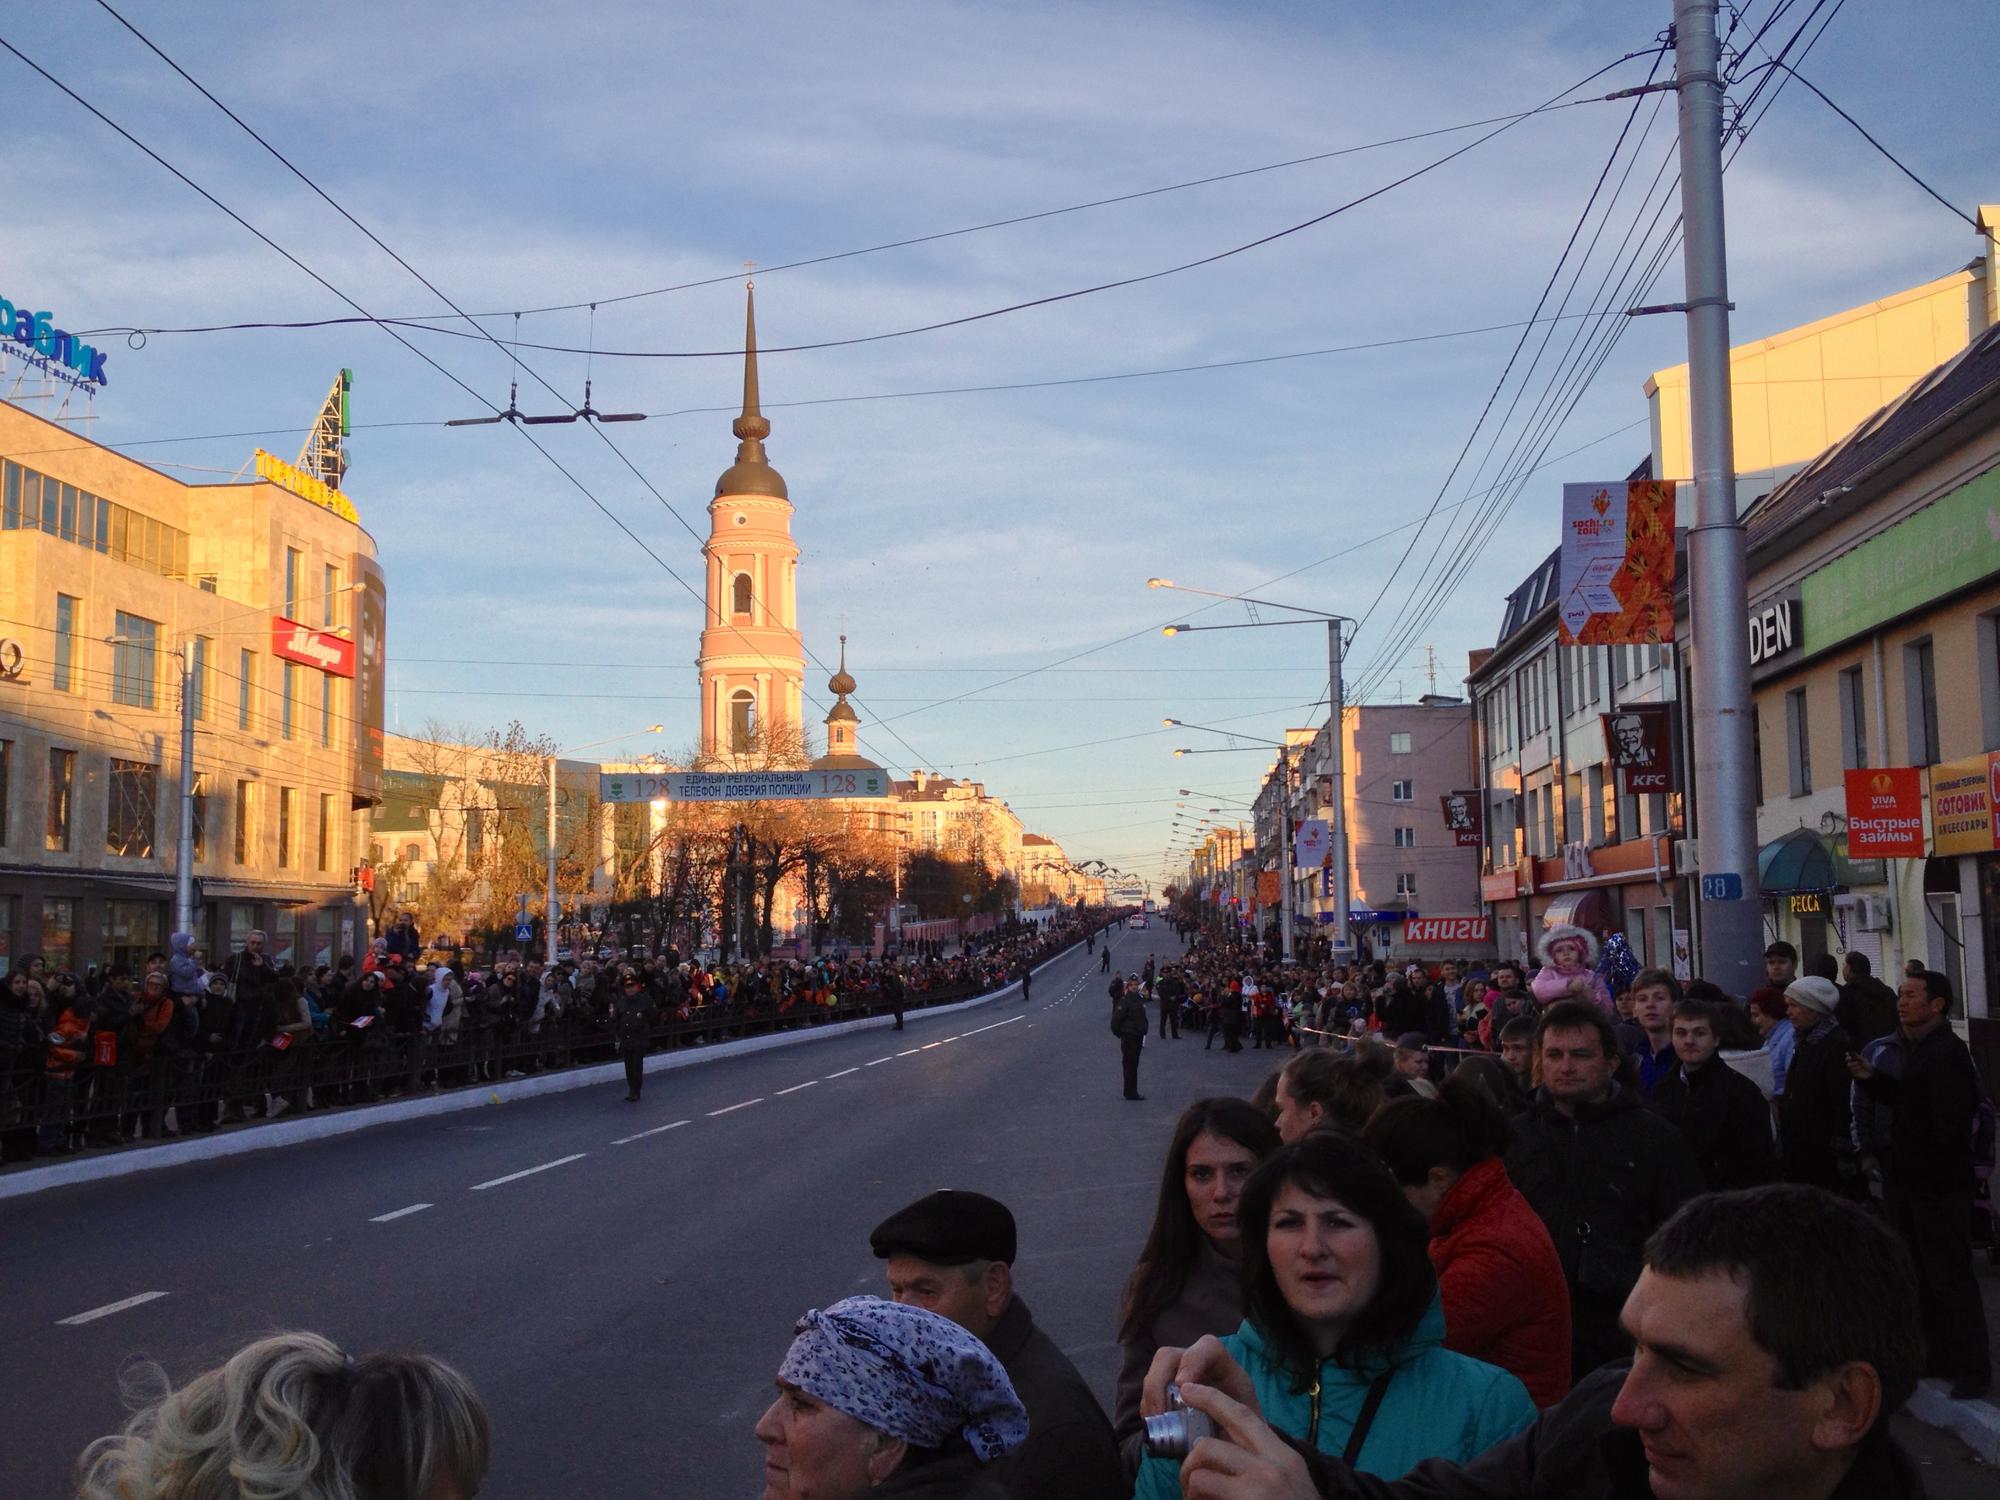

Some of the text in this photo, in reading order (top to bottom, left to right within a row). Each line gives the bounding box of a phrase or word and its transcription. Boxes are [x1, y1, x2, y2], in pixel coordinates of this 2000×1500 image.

[686, 773, 803, 785] ЕДИНЫЙ РЕГИОНАЛЬНЫЙ
[820, 774, 857, 794] 128
[1632, 774, 1666, 786] KFC
[635, 778, 670, 798] 128
[679, 783, 812, 798] ТЕЛЕФОН ДОВЕРИЯ ПОЛИЦИИ
[1872, 796, 1896, 804] VIVA
[1936, 791, 1987, 816] СОТОВИК
[1850, 816, 1921, 831] Быстрые
[1459, 833, 1481, 842] KFC
[1859, 828, 1913, 843] займы
[1703, 878, 1726, 899] 28
